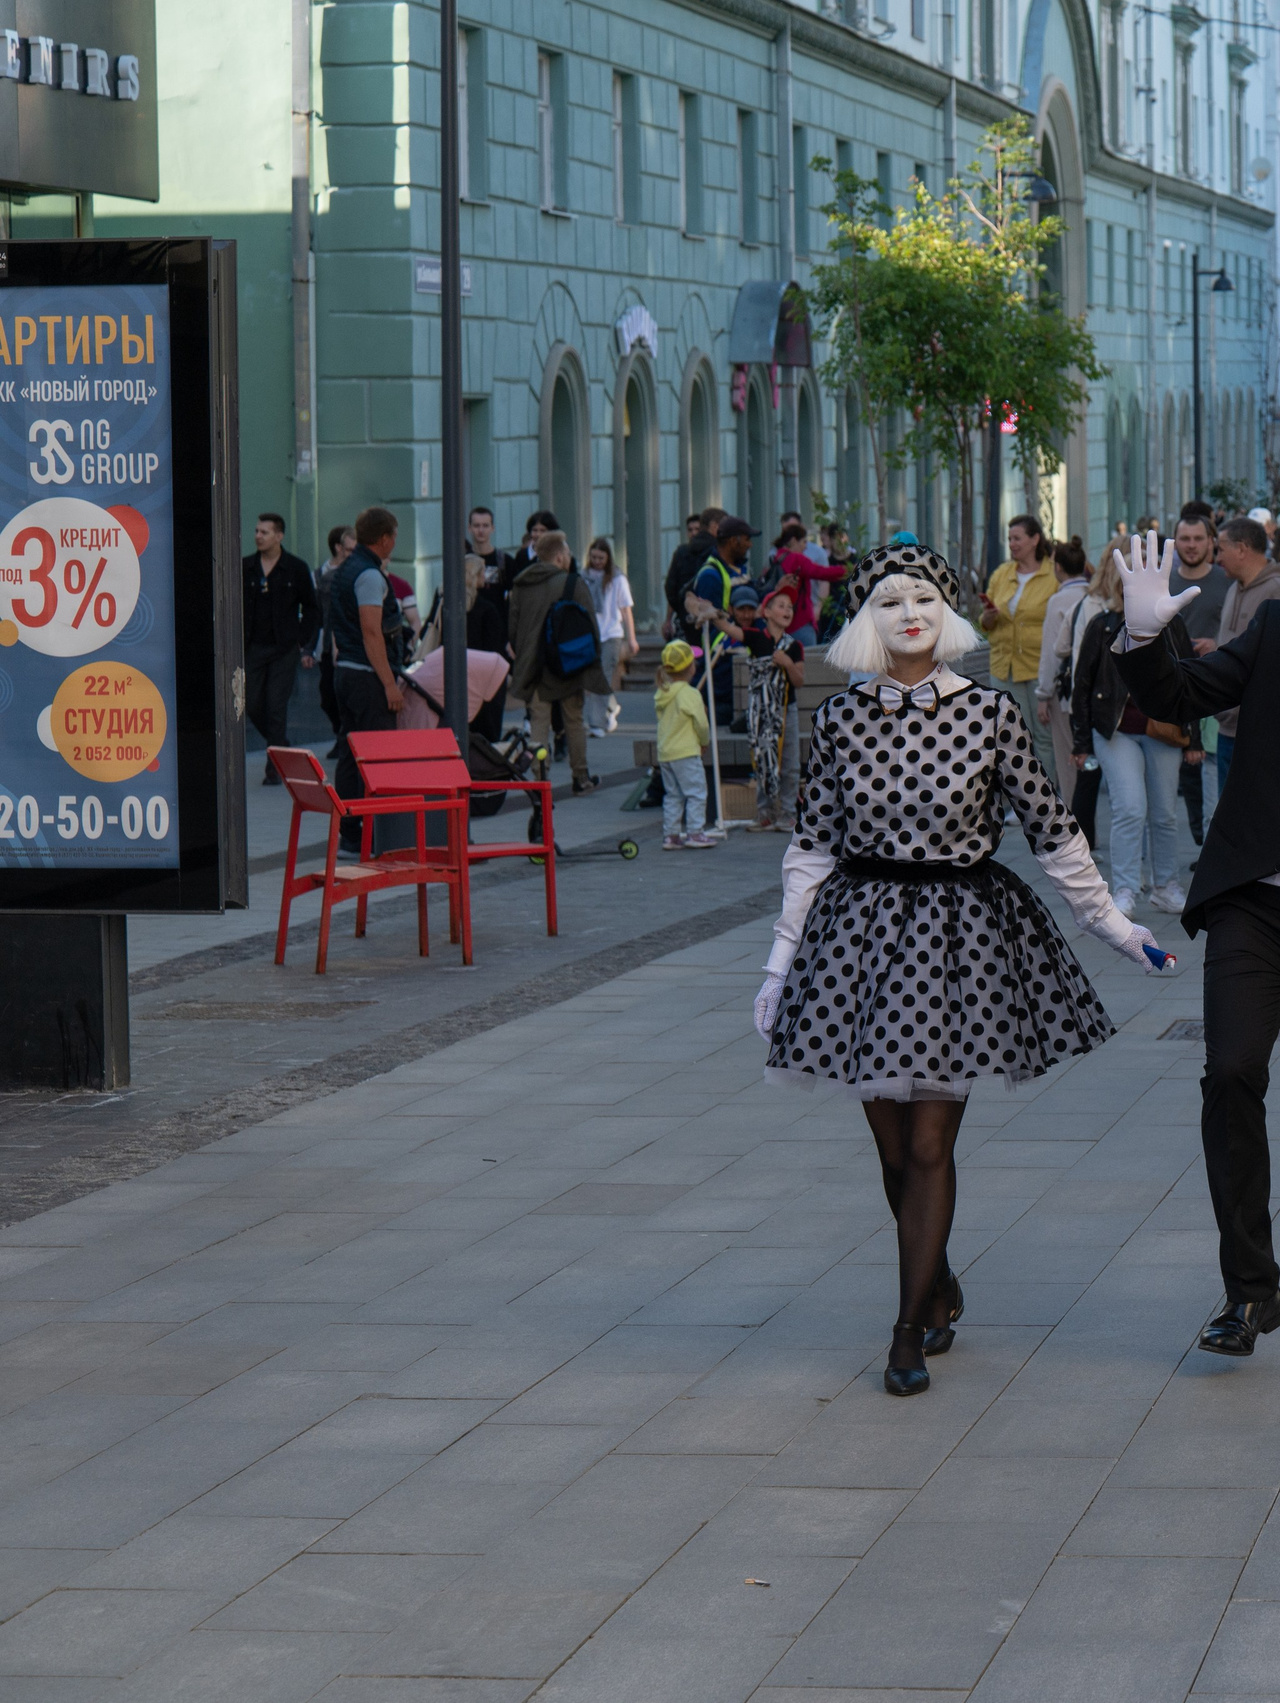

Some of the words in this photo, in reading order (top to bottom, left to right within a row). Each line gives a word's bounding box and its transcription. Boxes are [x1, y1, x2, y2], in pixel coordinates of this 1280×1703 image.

[0, 28, 140, 101] ENIRS
[20, 375, 89, 402] «НОВЫЙ
[94, 379, 157, 405] ГОРОД»
[81, 453, 159, 485] GROUP
[60, 528, 121, 551] КРЕДИТ
[11, 526, 117, 630] 3%
[84, 675, 110, 696] 22
[64, 708, 154, 739] СТУДИЯ
[73, 746, 82, 761] 2
[85, 746, 112, 761] 052
[0, 795, 170, 840] 20-50-00
